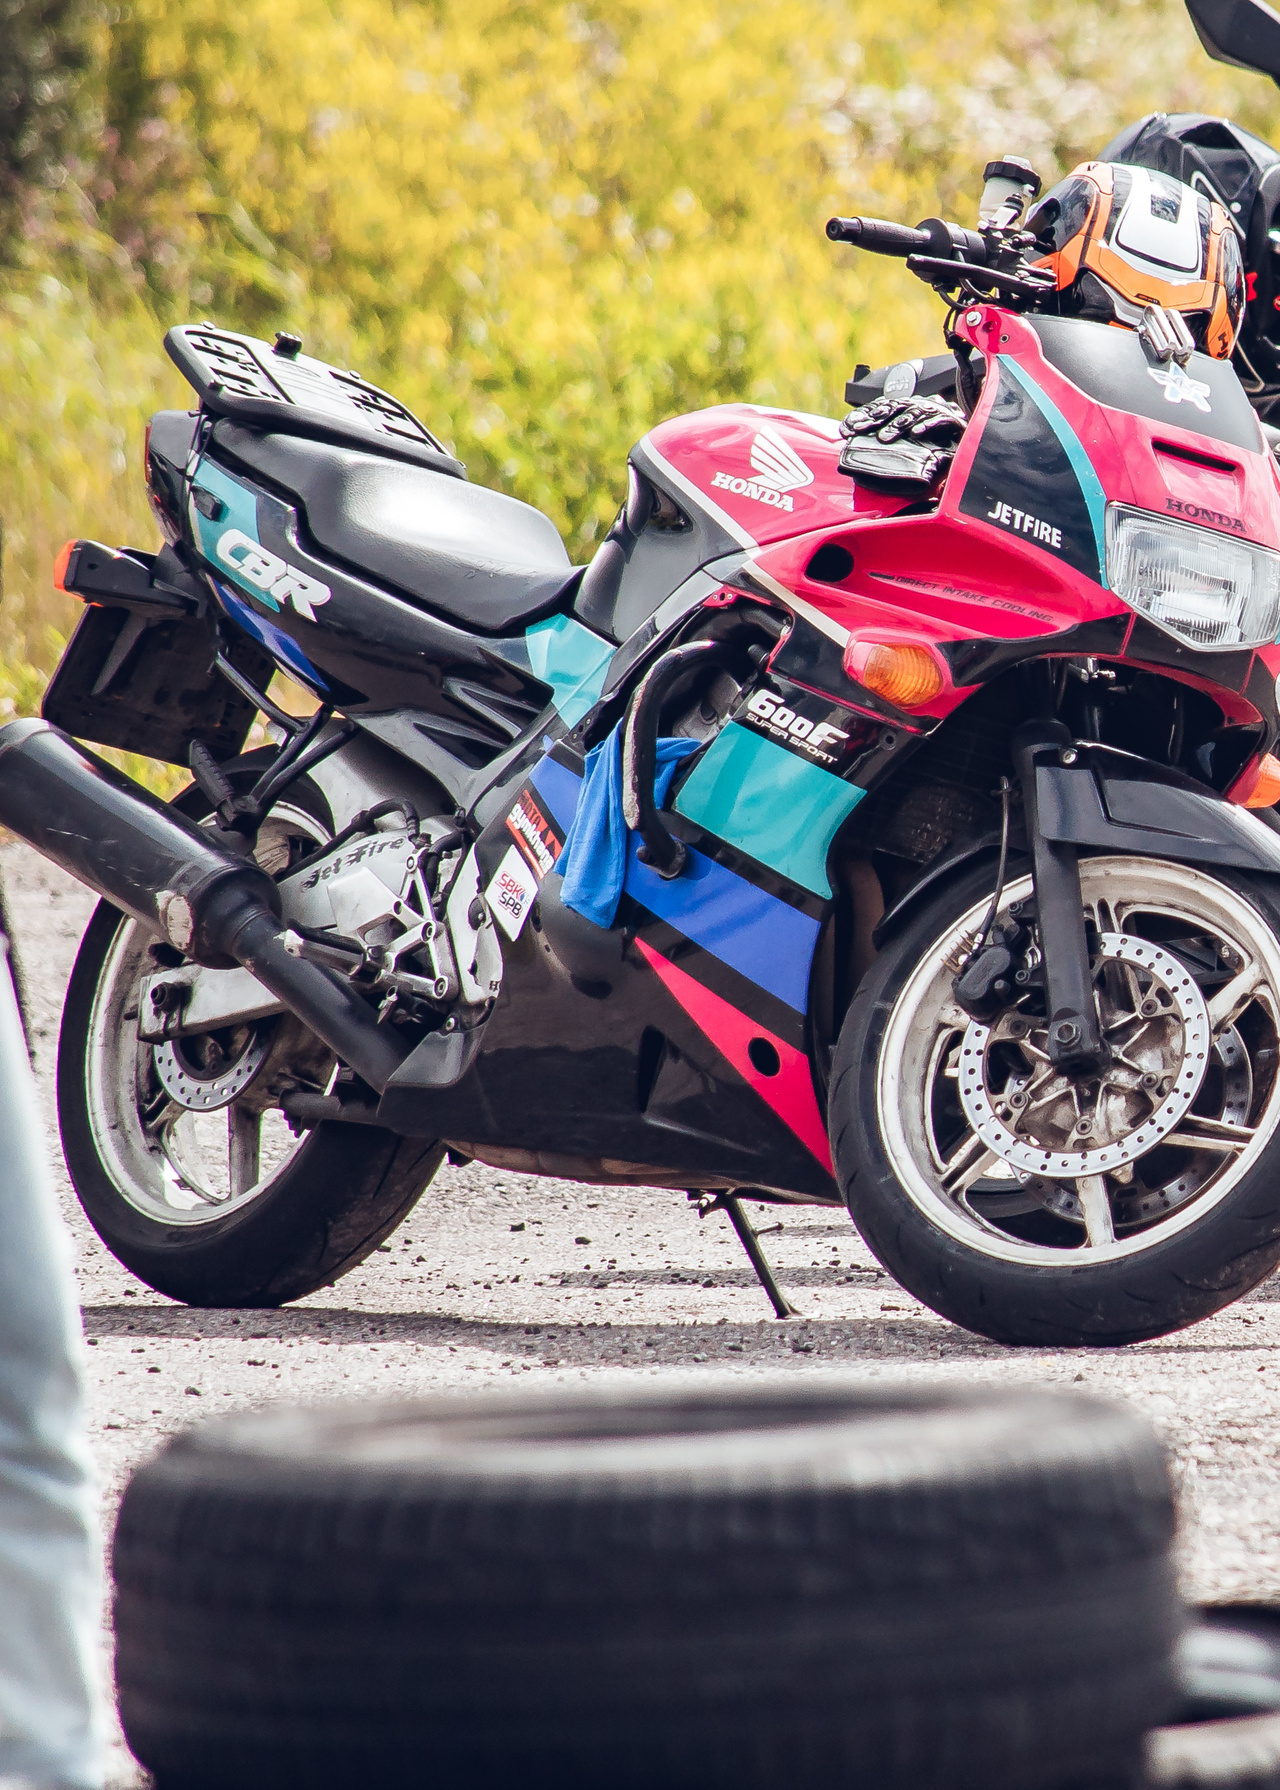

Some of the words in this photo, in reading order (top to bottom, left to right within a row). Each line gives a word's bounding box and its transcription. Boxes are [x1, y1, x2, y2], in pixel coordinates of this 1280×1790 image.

[711, 471, 794, 512] HONDA
[1165, 497, 1247, 533] HONDA
[987, 500, 1062, 548] JETFIRE
[216, 528, 332, 623] CBR
[895, 575, 940, 591] DIRECT
[942, 585, 988, 603] INTAKE
[992, 599, 1055, 622] COOLING
[746, 712, 789, 740] SUPER
[789, 736, 838, 764] SPORT
[747, 688, 850, 748] 600F
[499, 872, 522, 897] SBK
[499, 890, 522, 917] SPB
